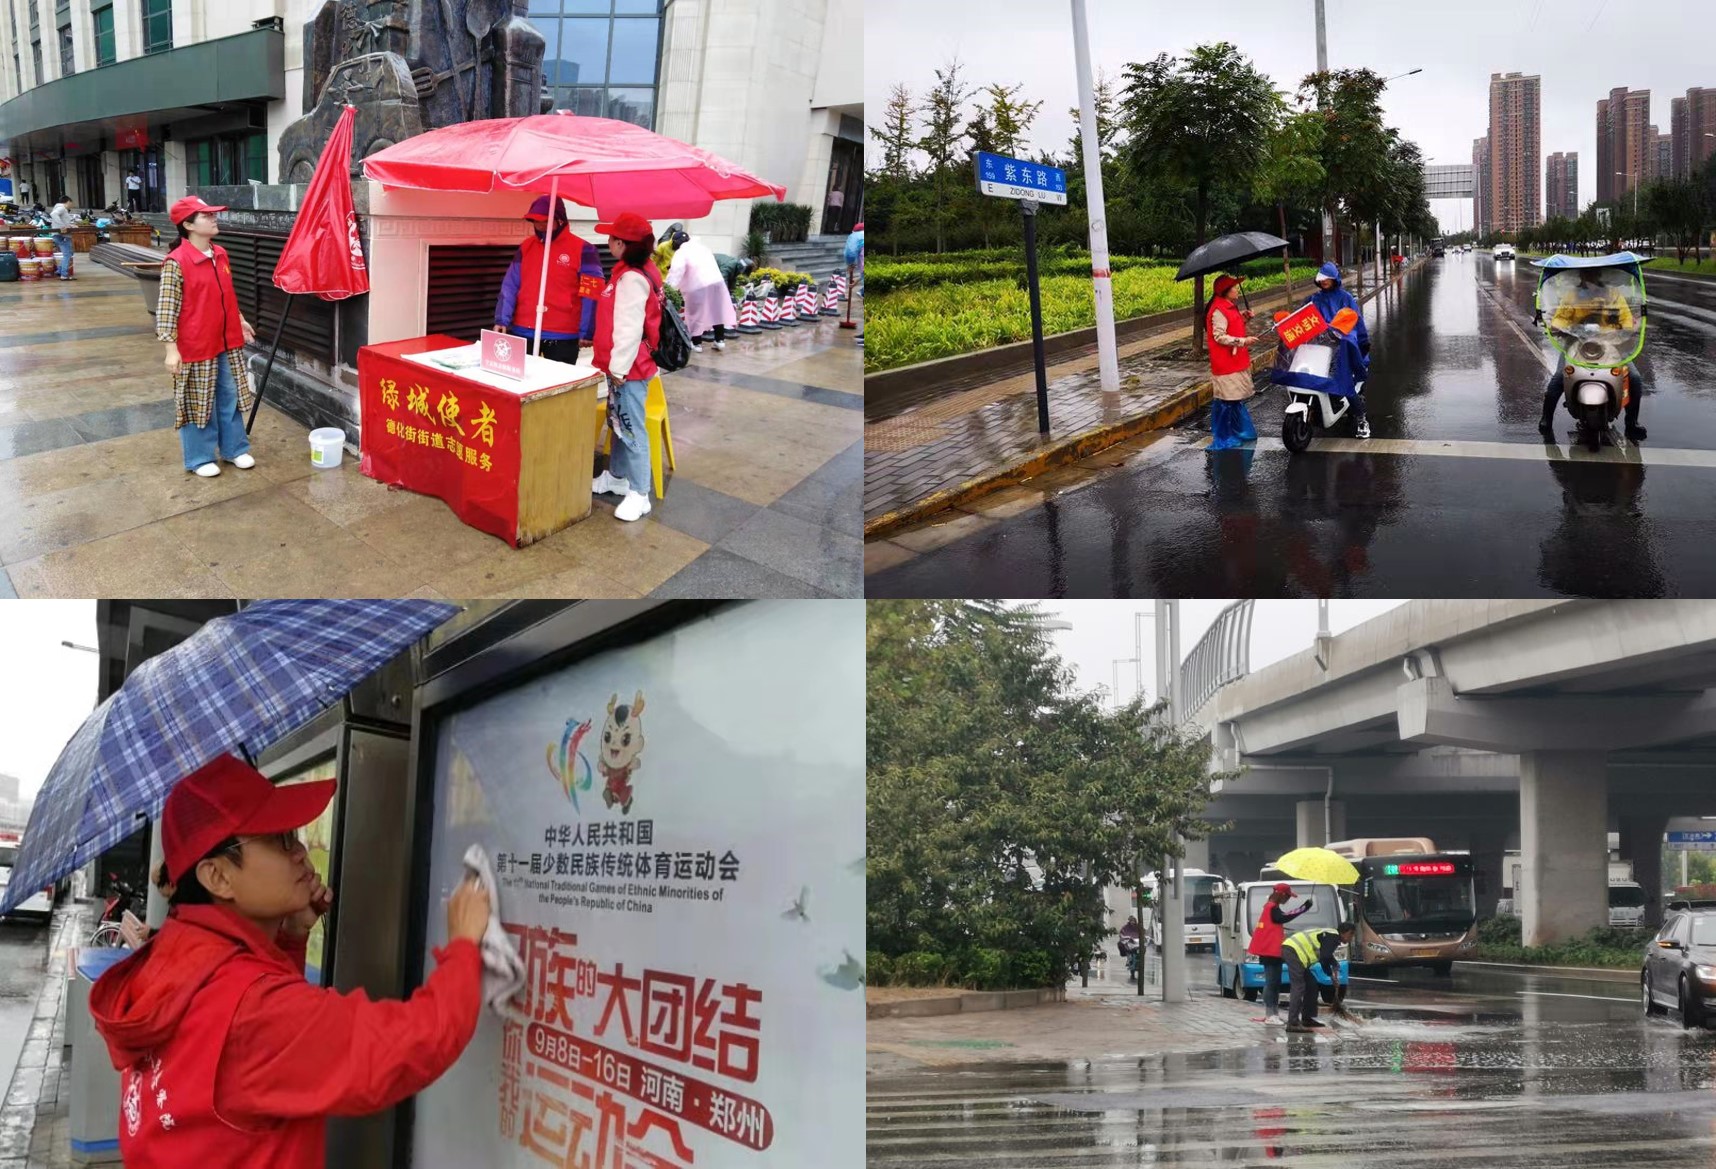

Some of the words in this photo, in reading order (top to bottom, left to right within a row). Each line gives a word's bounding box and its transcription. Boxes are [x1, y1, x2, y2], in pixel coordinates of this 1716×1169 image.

[1004, 163, 1047, 187] 紫东路
[988, 184, 994, 193] E
[1010, 187, 1034, 198] ZIDONG
[379, 377, 498, 448] 绿城使者
[385, 418, 493, 472] 德化街街道志愿服务
[545, 820, 653, 848] 中华人民共和国
[497, 850, 740, 882] 第十一届少数民族传统体育运动会
[525, 878, 549, 890] National
[551, 880, 588, 892] Traditional
[589, 882, 615, 895] Games
[618, 884, 626, 895] of
[628, 883, 657, 897] Ethnic
[659, 885, 709, 901] Minorities
[712, 887, 724, 901] of
[538, 893, 549, 903] the
[550, 894, 580, 907] People's
[581, 896, 614, 910] Republic
[616, 900, 625, 911] of
[626, 900, 653, 913] China
